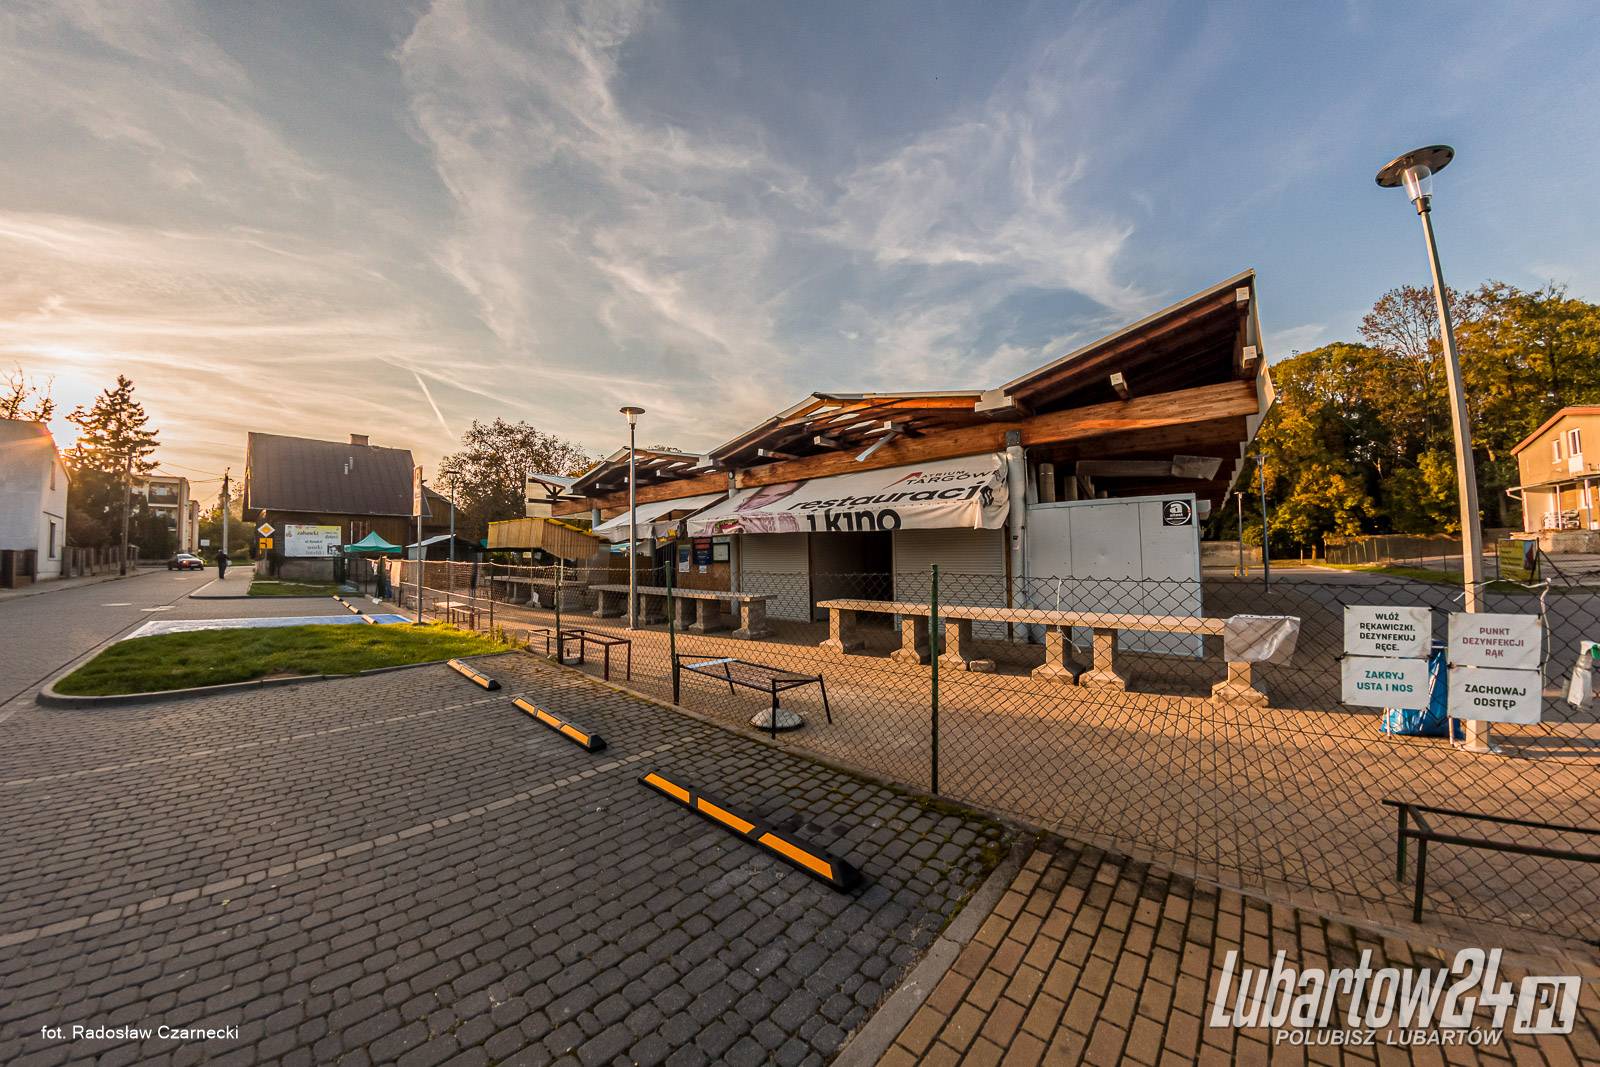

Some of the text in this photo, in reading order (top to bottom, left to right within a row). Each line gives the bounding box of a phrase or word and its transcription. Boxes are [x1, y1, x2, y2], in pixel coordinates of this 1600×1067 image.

[824, 506, 902, 532] kino
[1375, 612, 1400, 621] WŁÓŻ
[1359, 622, 1416, 632] RĘKAWICZKI.
[1479, 627, 1511, 636] PUNKT
[1359, 632, 1416, 642] DEZYNFEKUJ
[1462, 637, 1524, 647] DEZYNFEKCJI
[1375, 643, 1400, 652] RĘCE.
[1485, 648, 1504, 659] RĄK
[1365, 670, 1405, 680] ZAKRYJ
[1356, 682, 1414, 693] USTA I NOS
[1464, 683, 1527, 697] ZACHOWAJ
[1473, 697, 1517, 710] ODSTĘP
